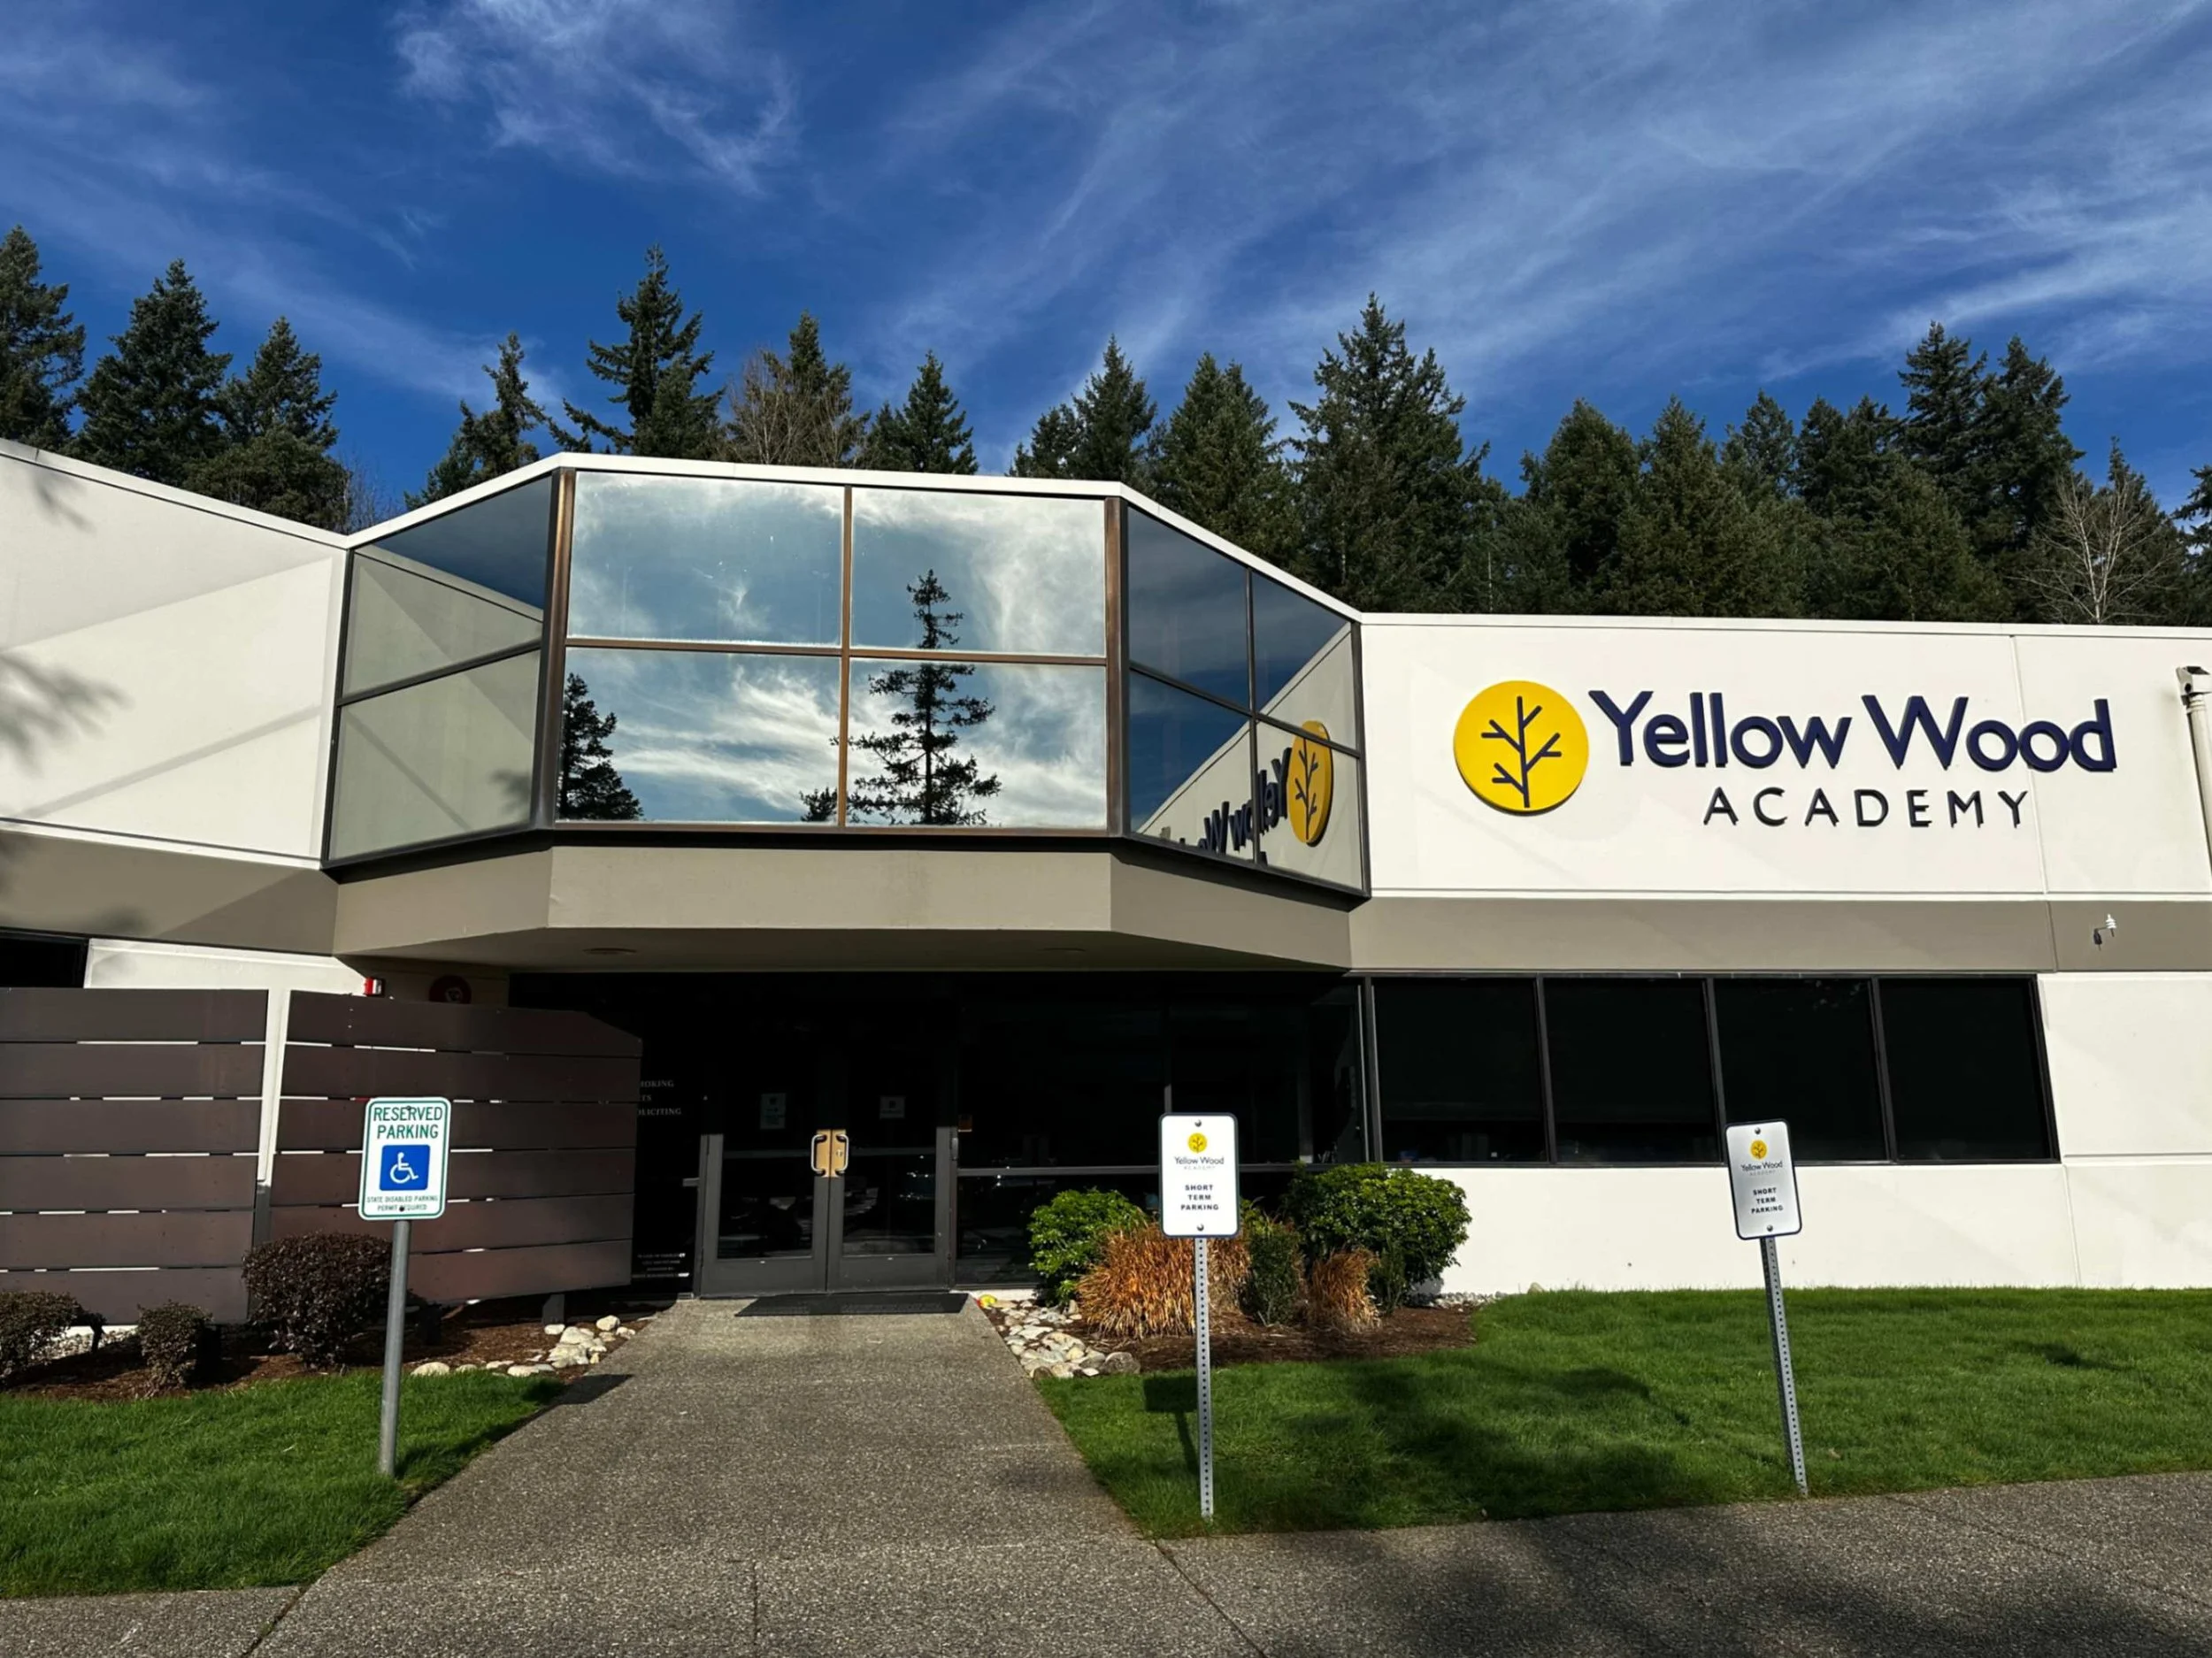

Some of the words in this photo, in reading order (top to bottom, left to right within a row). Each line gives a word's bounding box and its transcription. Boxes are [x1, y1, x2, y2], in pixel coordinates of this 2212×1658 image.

[1588, 690, 1853, 769] Yellow
[1861, 695, 2117, 772] Wood
[1703, 787, 2028, 828] ACADEMY
[641, 1079, 674, 1089] OKING
[373, 1107, 443, 1122] RESERVED
[377, 1125, 439, 1140] PARKING
[1762, 1160, 1783, 1169] Wood
[1751, 1204, 1784, 1214] PARKING
